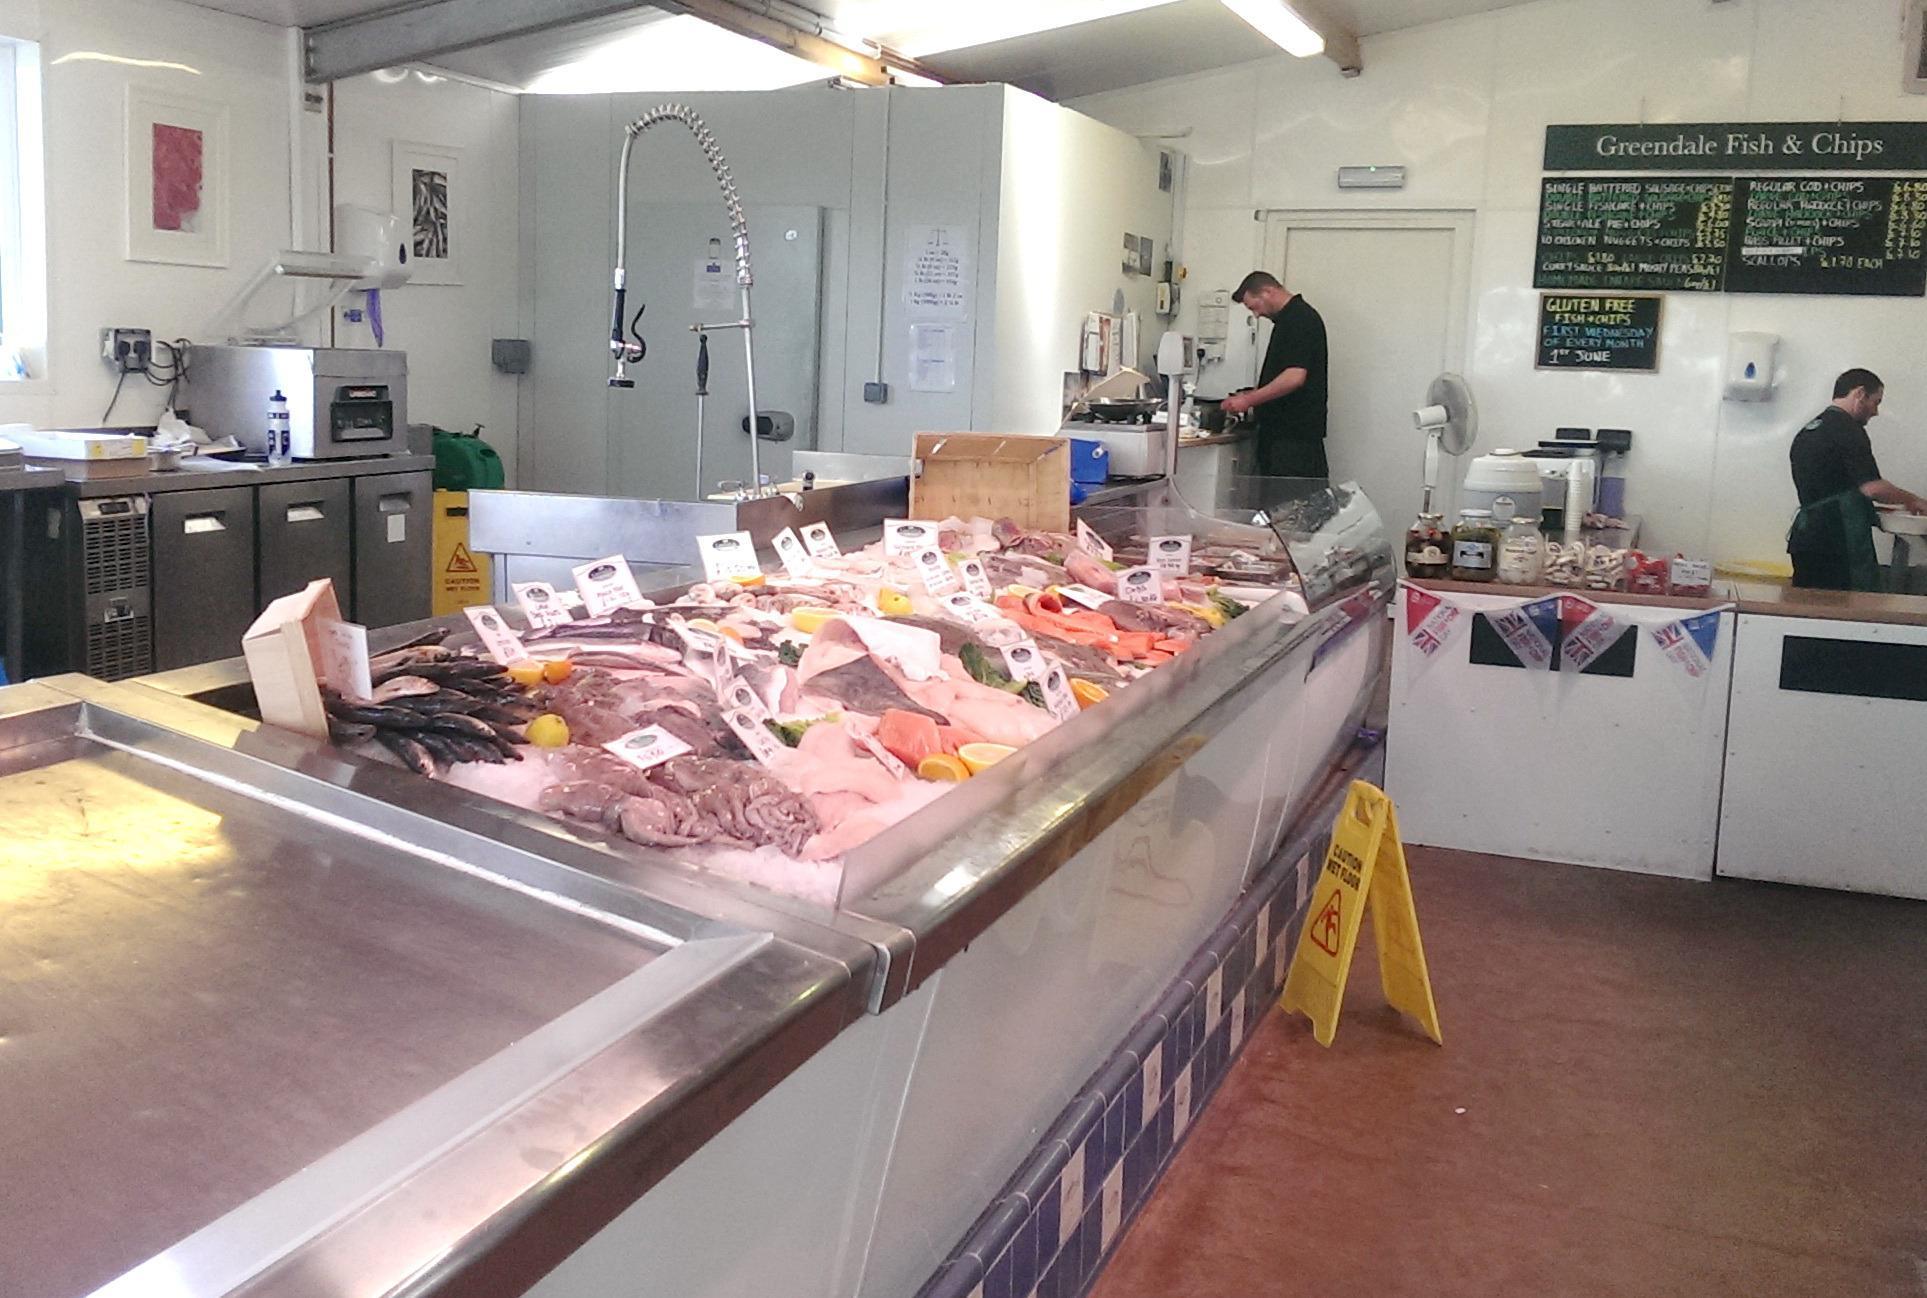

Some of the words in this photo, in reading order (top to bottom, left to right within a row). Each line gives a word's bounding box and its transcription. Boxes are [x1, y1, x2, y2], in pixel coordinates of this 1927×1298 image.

[1596, 134, 1718, 156] Greendale
[1725, 133, 1774, 155] Fish
[1782, 134, 1803, 155] &
[1812, 132, 1885, 160] Chips
[1742, 256, 1802, 266] SCALLOPS
[1858, 257, 1883, 269] EACH
[1546, 298, 1600, 312] GLUTEN
[1606, 300, 1636, 312] FREE
[1542, 326, 1580, 336] FIRST
[1585, 327, 1654, 339] WEDNESDAY
[1544, 338, 1560, 348] OF
[1566, 338, 1602, 348] EVERY
[1606, 339, 1644, 348] MONTH
[1575, 350, 1612, 362] JUNE
[1333, 844, 1363, 874] CAUTION
[1326, 858, 1342, 878] WET
[1340, 866, 1361, 892] FLOOR
